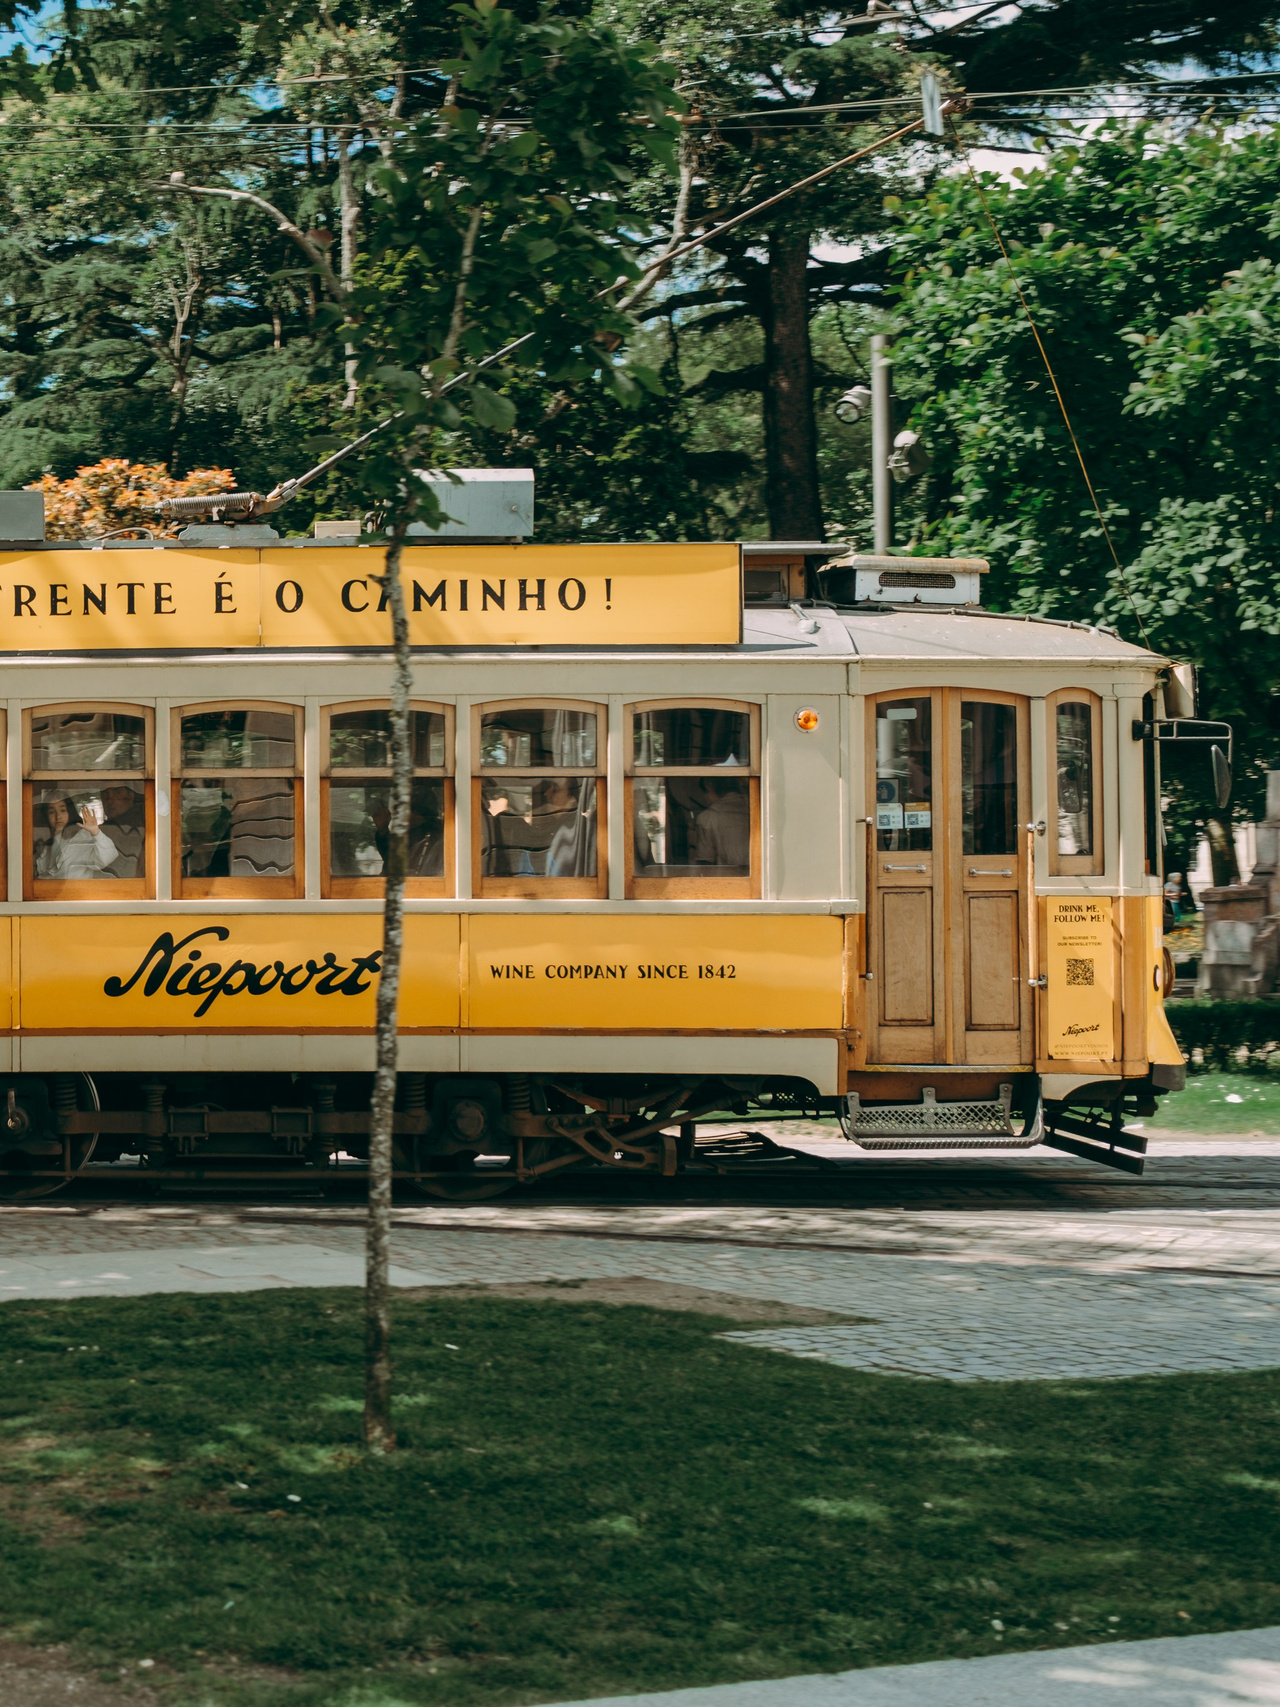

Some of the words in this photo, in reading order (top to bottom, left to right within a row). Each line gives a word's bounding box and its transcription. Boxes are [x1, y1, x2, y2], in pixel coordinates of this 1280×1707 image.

[214, 571, 237, 614] É
[275, 579, 304, 613] O
[1058, 904, 1083, 912] DRINK
[1053, 914, 1087, 922] FOLLOW
[1090, 914, 1105, 922] ME!
[103, 926, 384, 1018] Niepoort
[490, 964, 536, 979] WINE
[544, 964, 629, 979] COMPANY
[637, 964, 689, 979] SINCE
[697, 964, 737, 979] 1842
[1062, 1023, 1100, 1037] Niepoort
